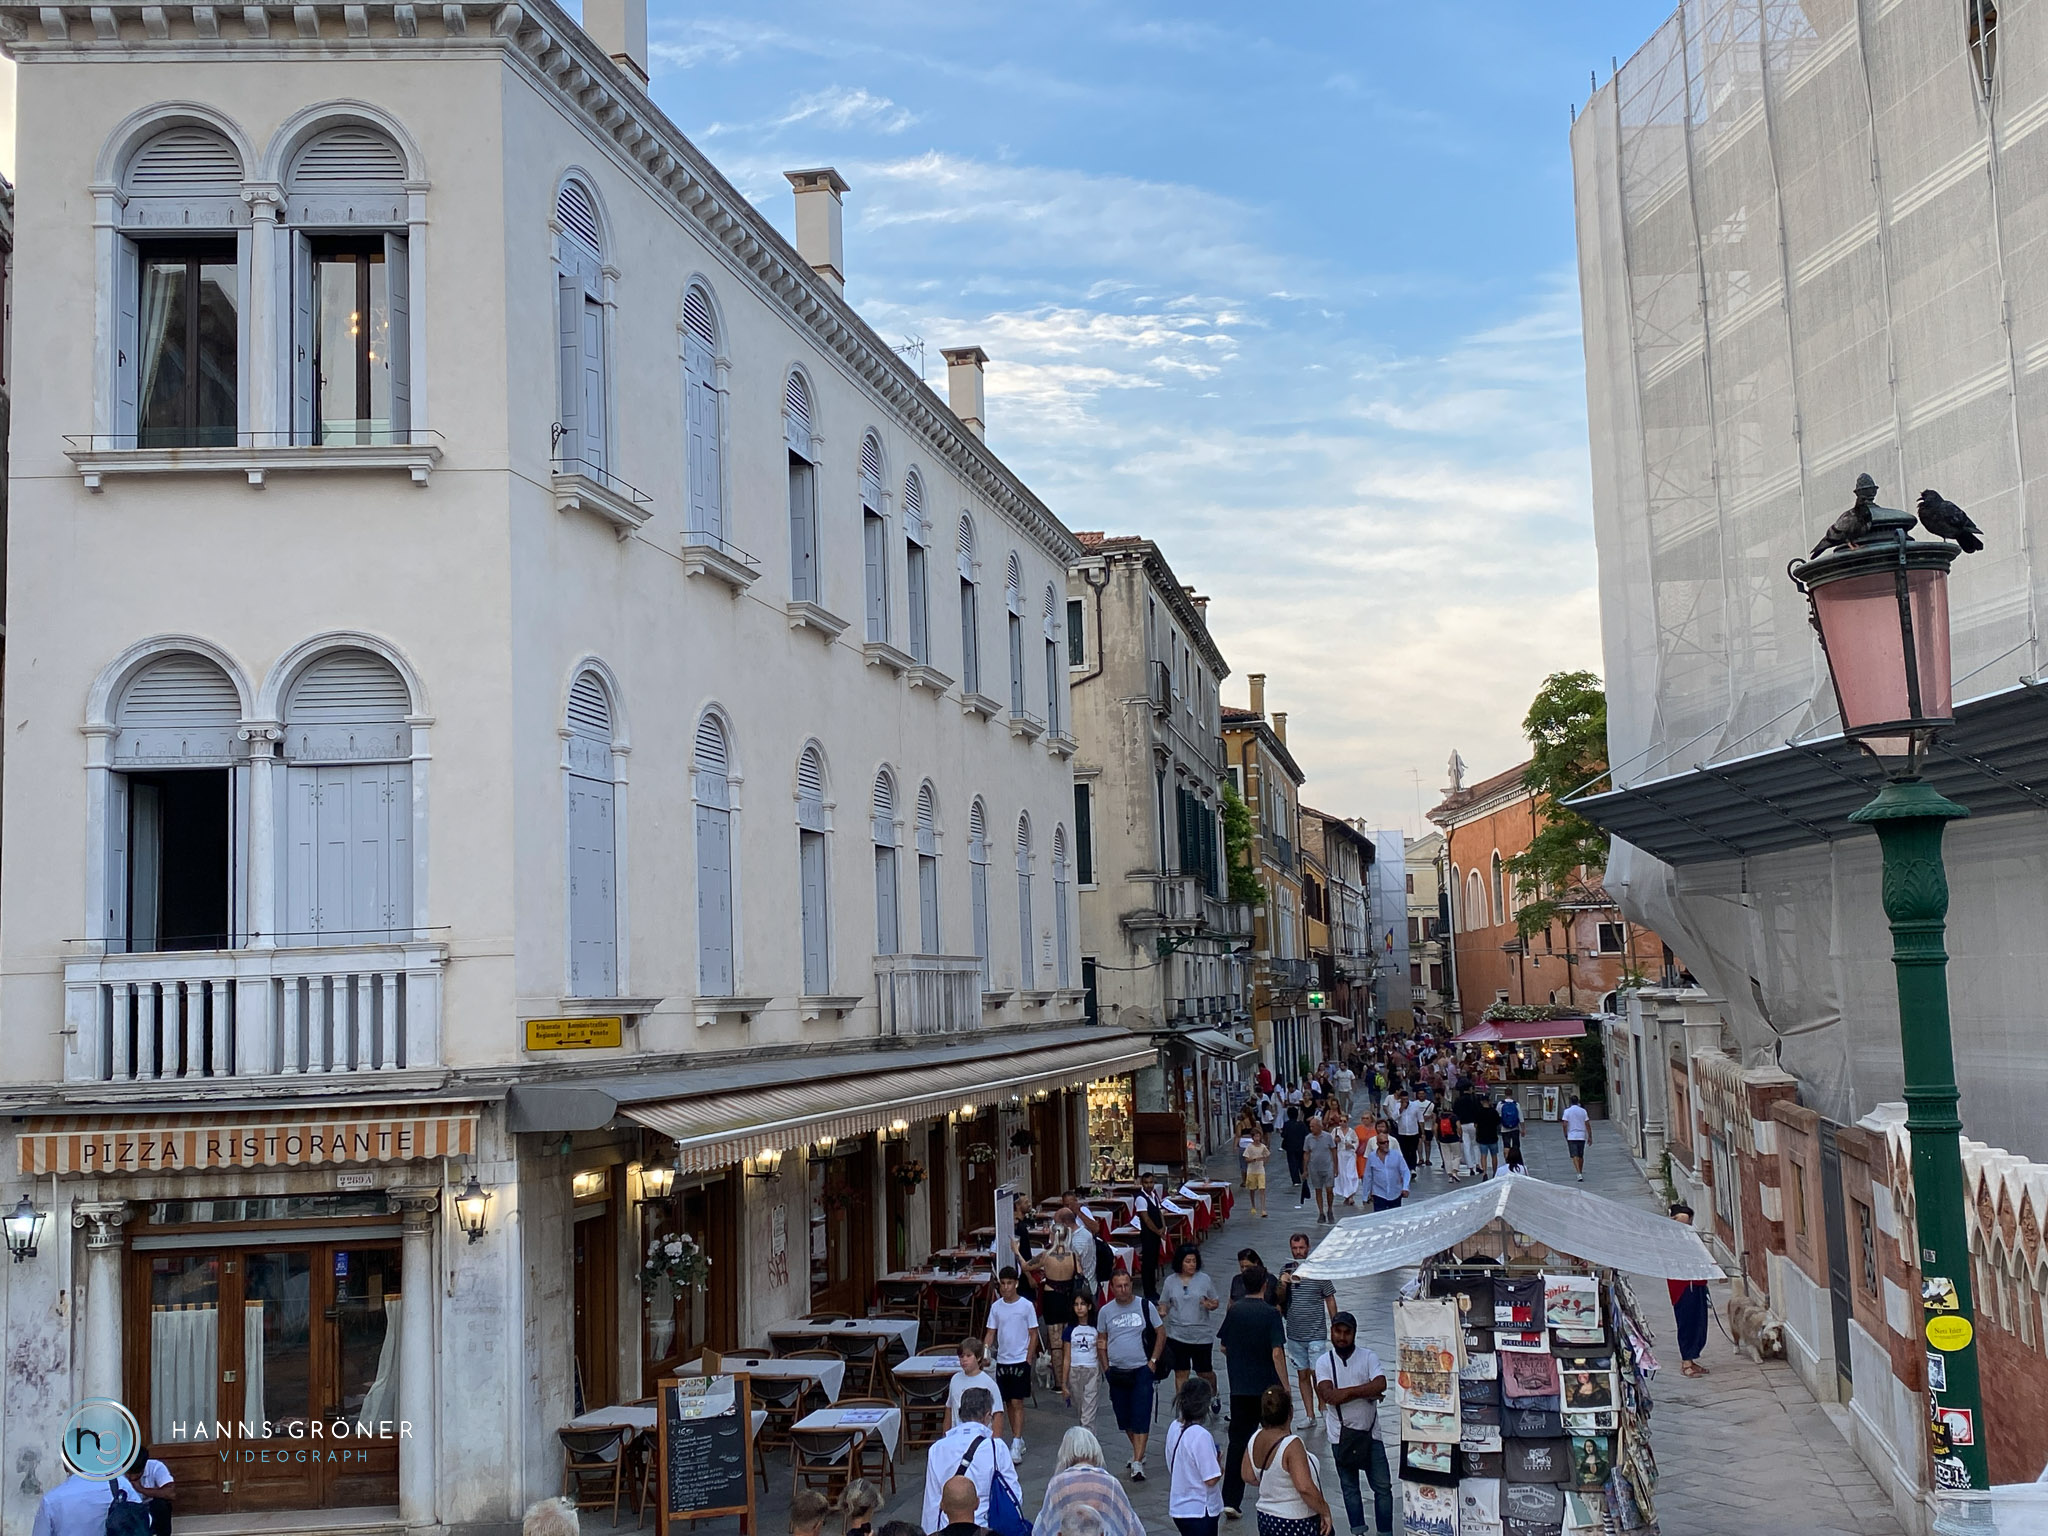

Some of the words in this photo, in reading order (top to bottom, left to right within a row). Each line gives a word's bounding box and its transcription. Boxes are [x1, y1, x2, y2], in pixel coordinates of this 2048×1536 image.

[84, 1141, 178, 1163] PIZZA
[207, 1131, 412, 1158] RISTORANTE
[1544, 1284, 1570, 1299] Spritz
[1465, 1332, 1478, 1346] ino
[1502, 1339, 1541, 1347] ORIGINAL
